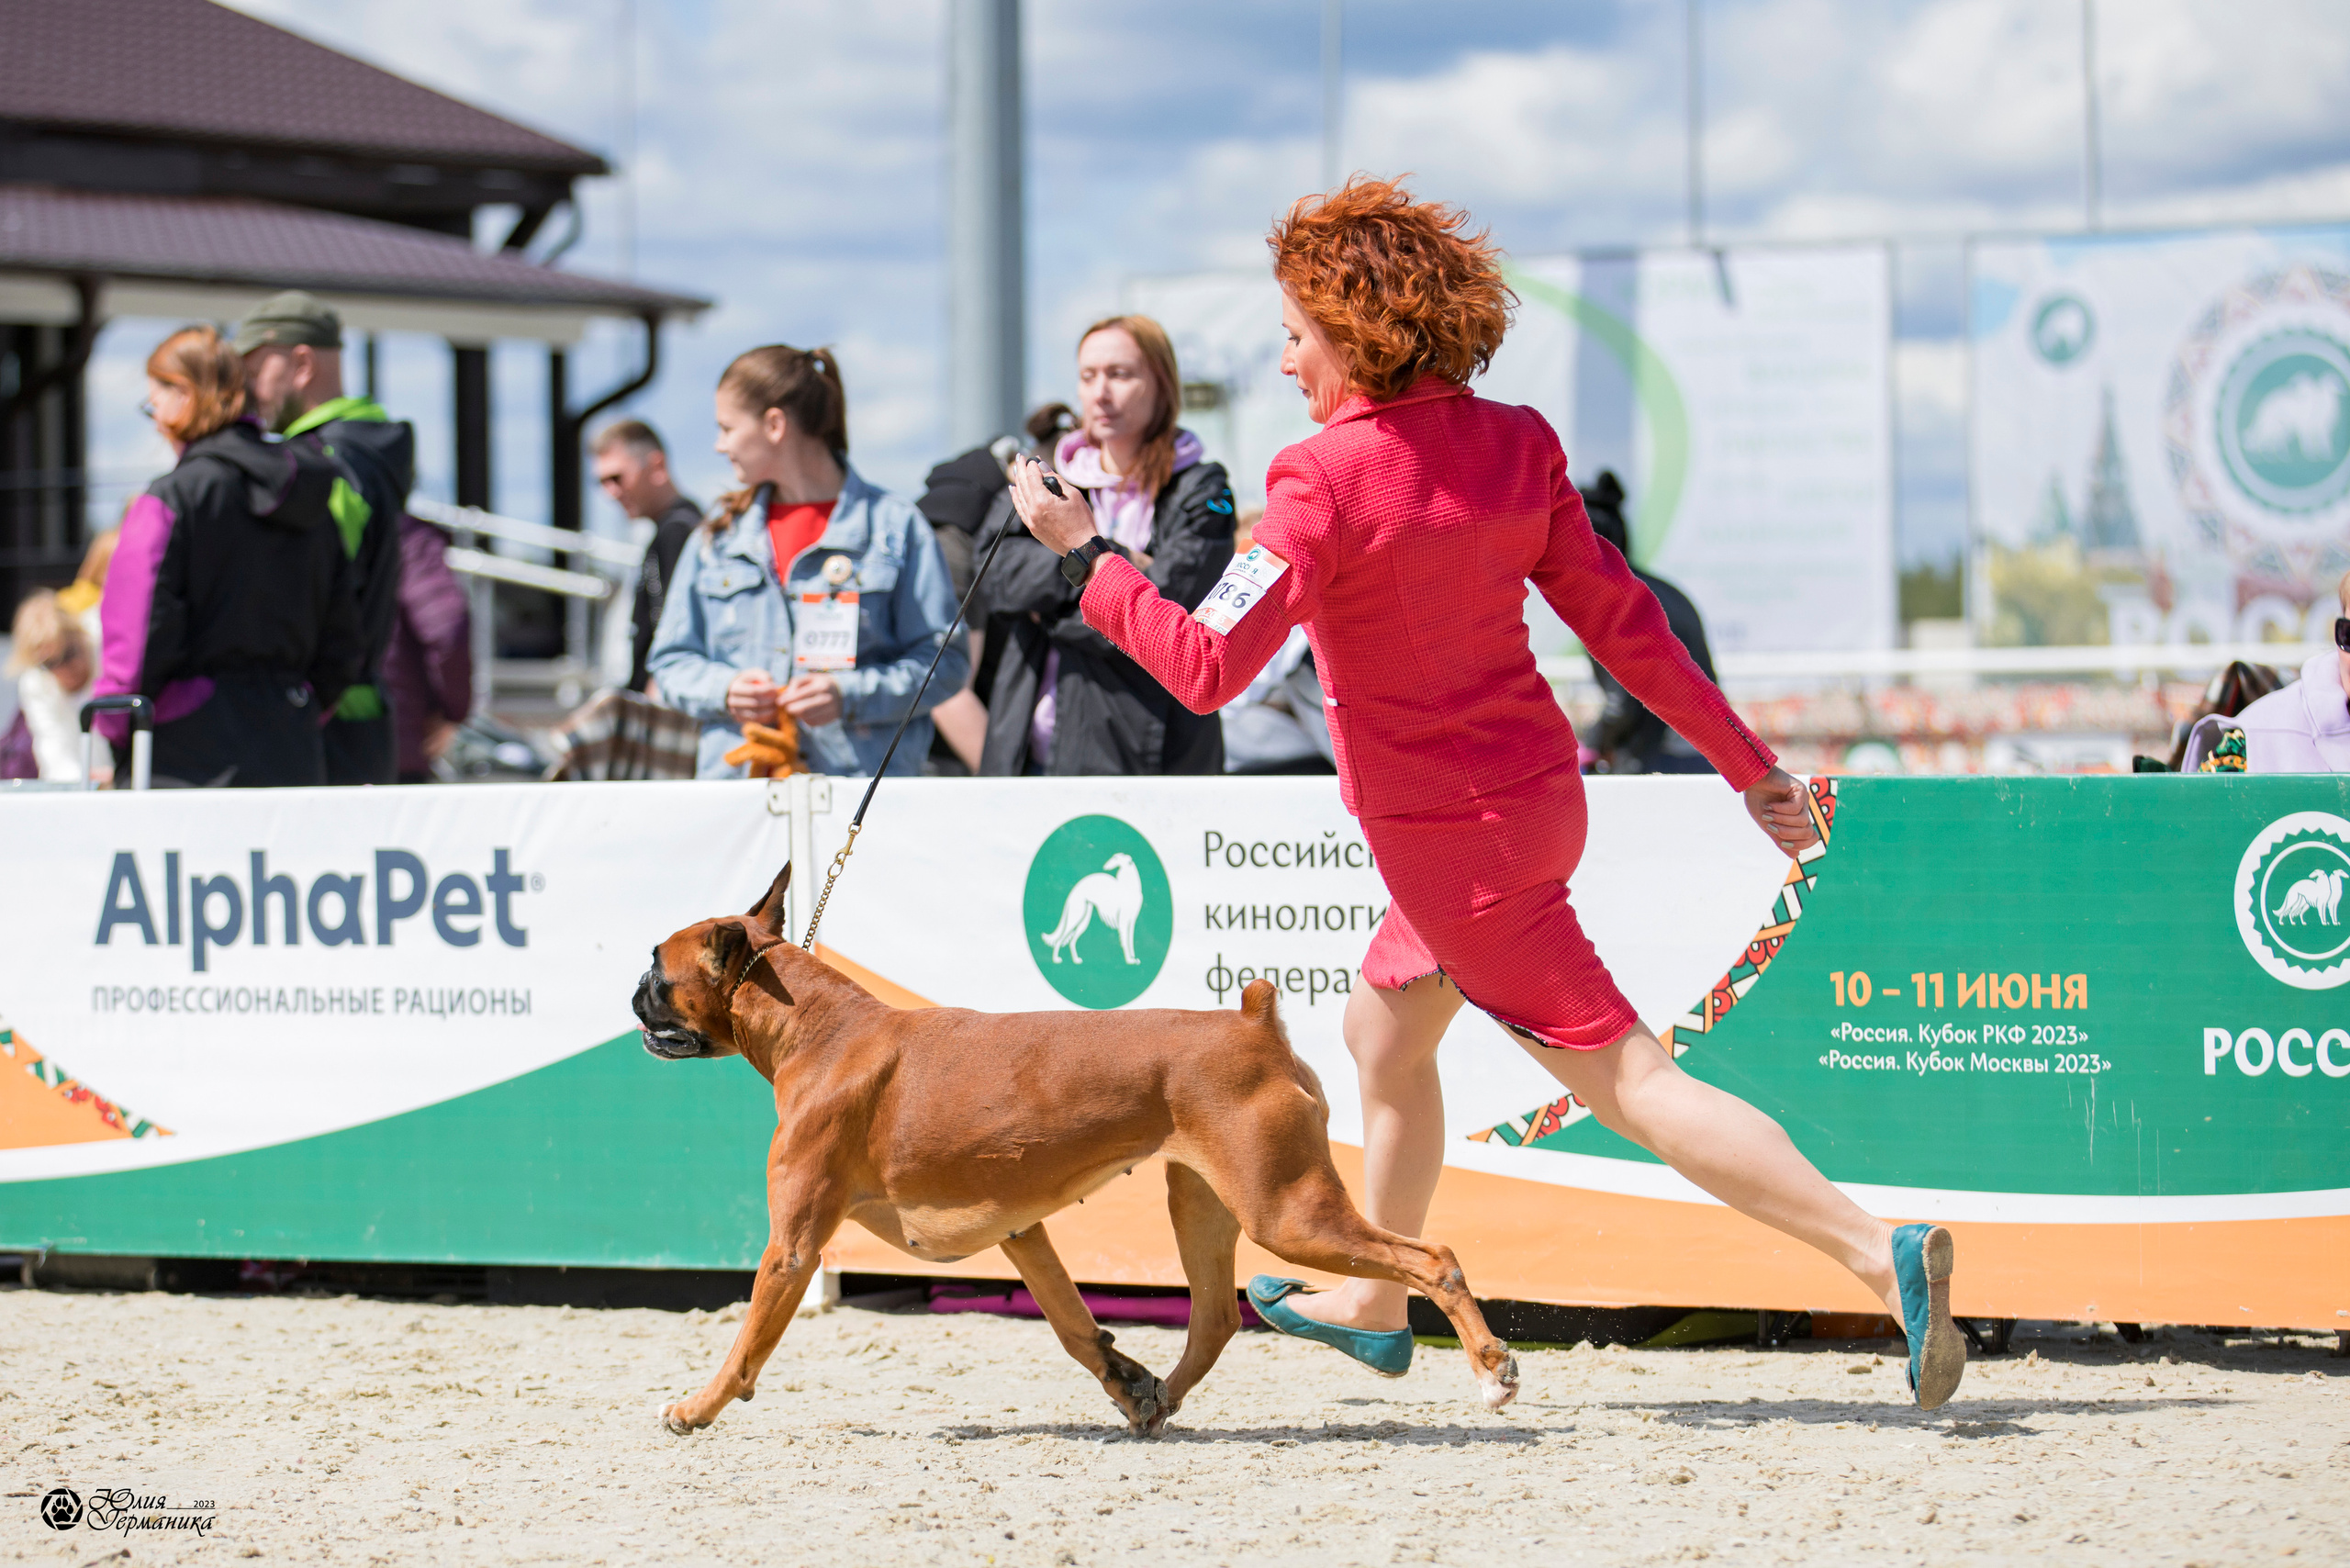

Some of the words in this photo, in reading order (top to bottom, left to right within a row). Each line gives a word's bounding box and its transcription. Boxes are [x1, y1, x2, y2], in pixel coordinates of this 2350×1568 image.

[1205, 952, 1360, 1006] федера
[1830, 970, 1873, 1007] 10
[1910, 971, 1944, 1008] 11
[1957, 971, 2088, 1010] ИЮНЯ
[92, 985, 385, 1014] ПРОФЕССИОНАЛЬНЫЕ
[394, 987, 533, 1019] РАЦИОНЫ
[1830, 1021, 1913, 1044] «Россия.
[1918, 1022, 1978, 1049] Кубок
[1983, 1024, 2027, 1046] РКФ
[2031, 1025, 2089, 1047] 2023»
[1818, 1048, 1901, 1071] «Россия.
[1906, 1050, 1965, 1077] Кубок
[1970, 1052, 2049, 1074] Москвы
[2053, 1053, 2112, 1074] 2023»
